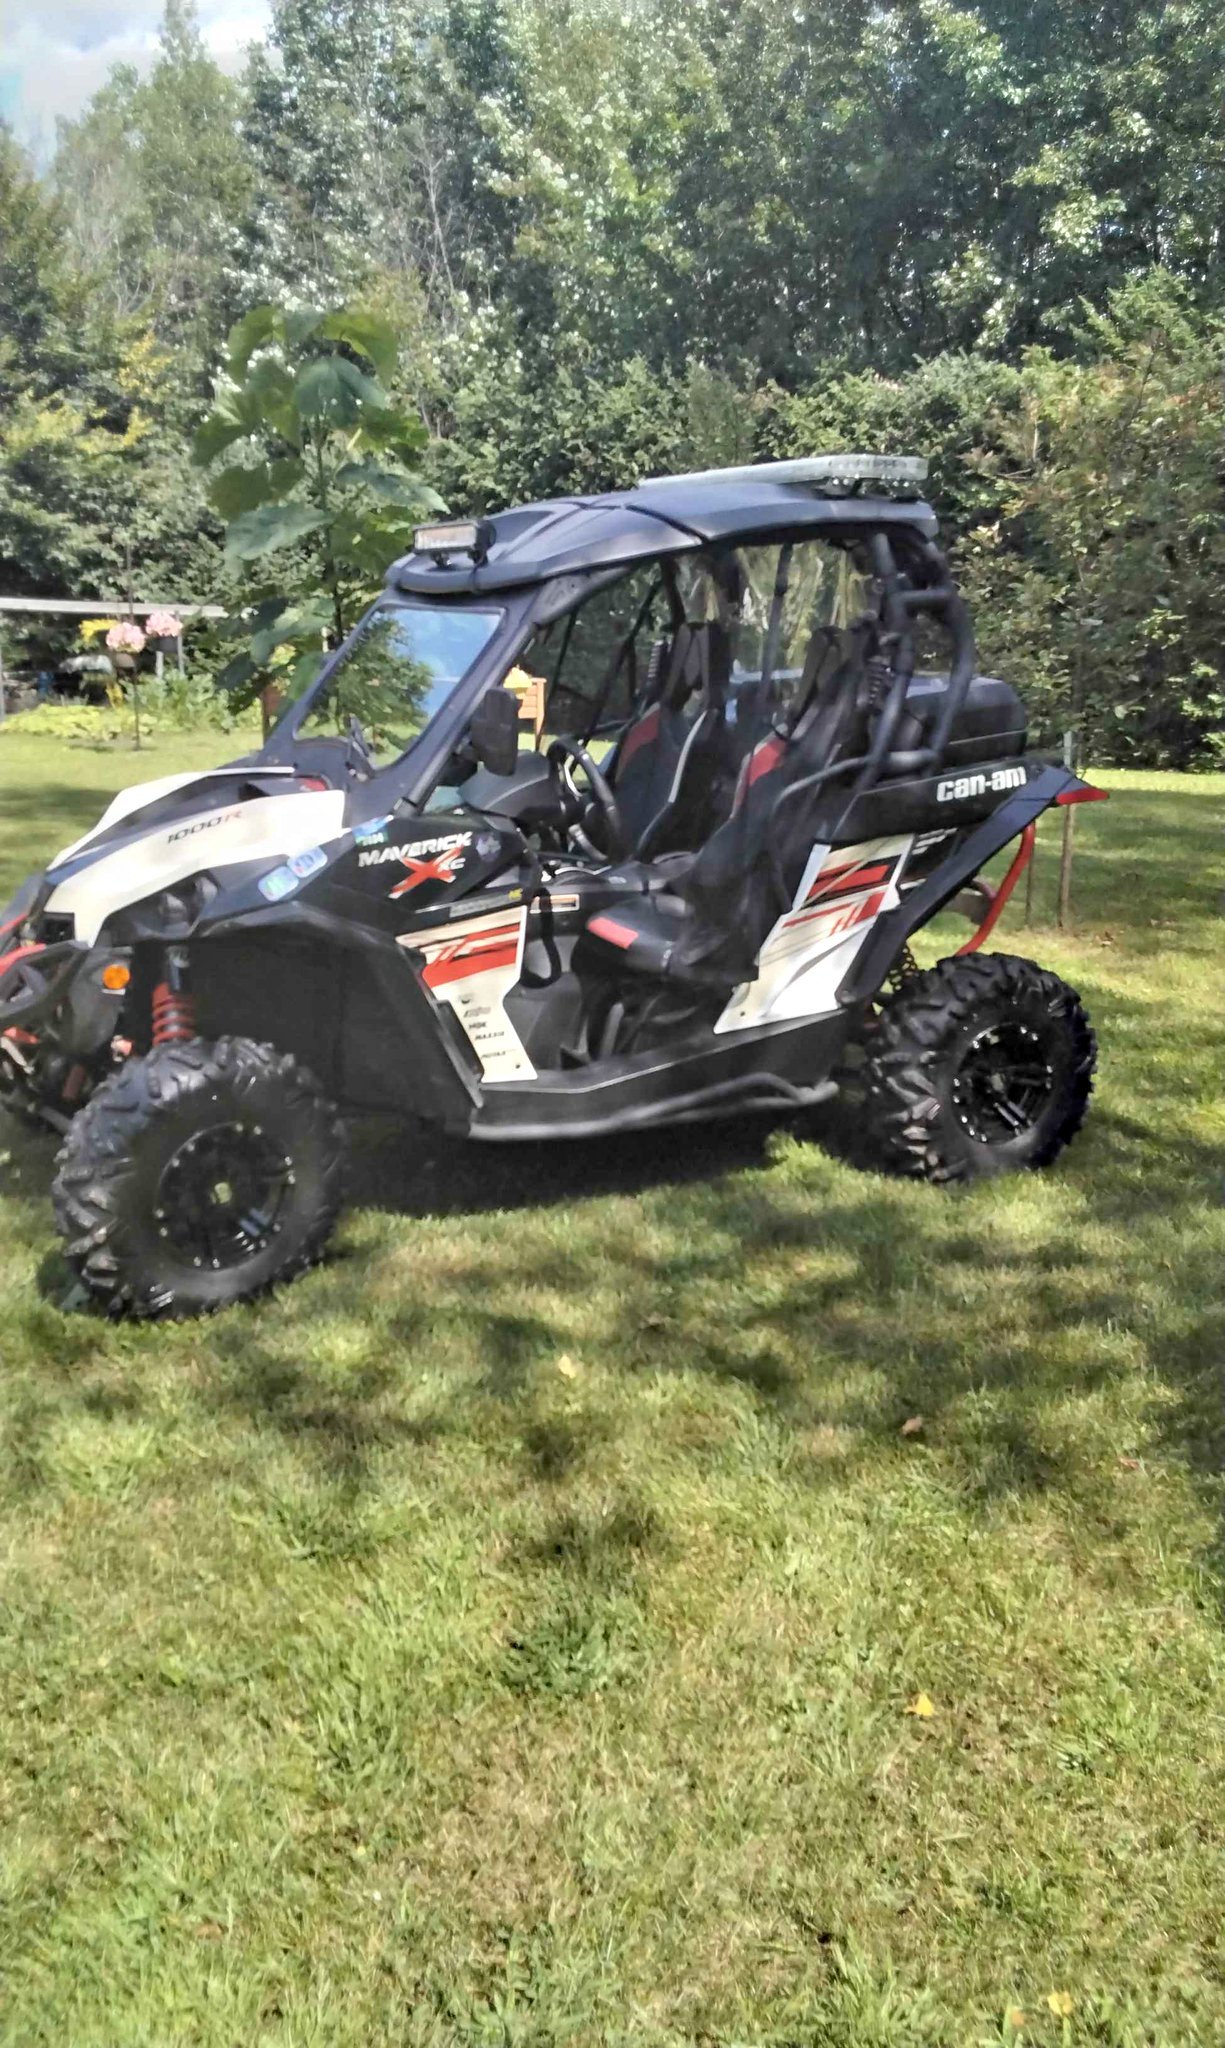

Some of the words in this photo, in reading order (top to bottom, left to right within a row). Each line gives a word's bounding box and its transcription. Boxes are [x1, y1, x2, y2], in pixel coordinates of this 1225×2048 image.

[936, 766, 1027, 802] can-am
[167, 810, 242, 844] 1000R
[358, 831, 473, 867] MAVERICK
